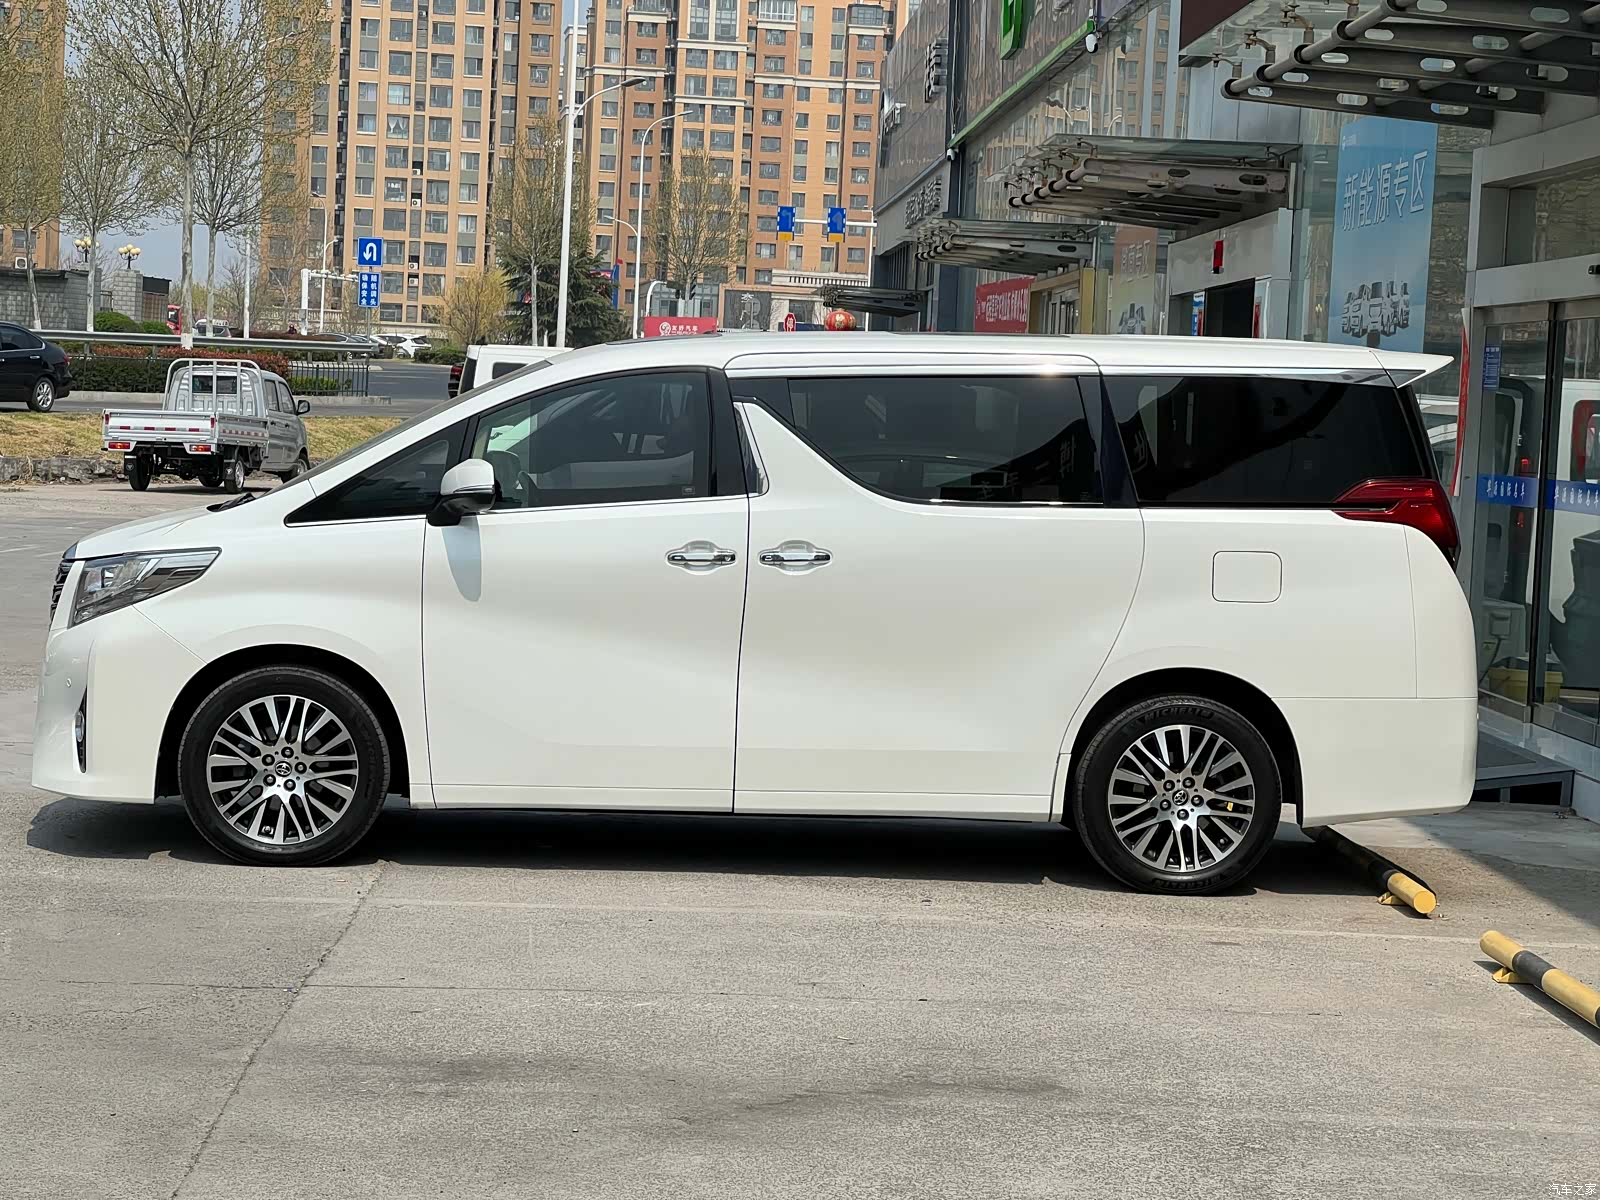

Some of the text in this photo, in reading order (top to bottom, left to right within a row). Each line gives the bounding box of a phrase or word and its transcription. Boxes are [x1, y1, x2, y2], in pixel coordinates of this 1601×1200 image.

[1342, 151, 1428, 231] 新能源专区
